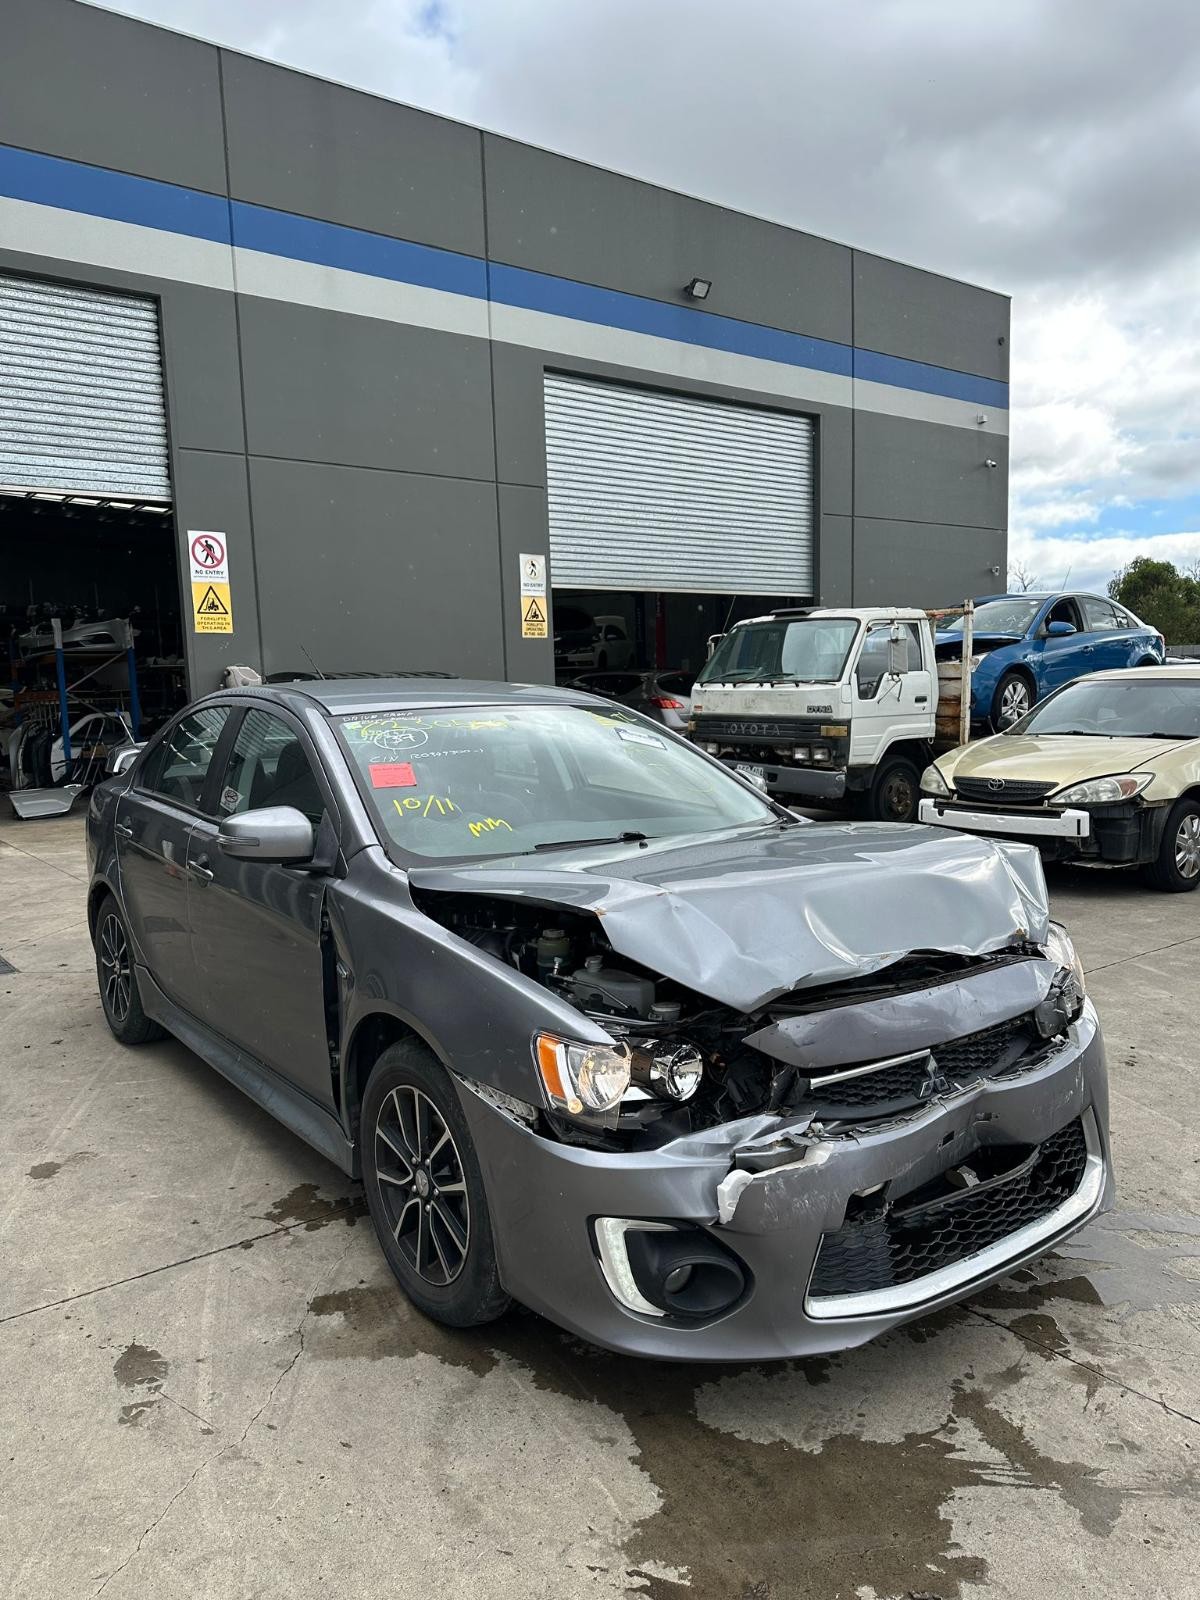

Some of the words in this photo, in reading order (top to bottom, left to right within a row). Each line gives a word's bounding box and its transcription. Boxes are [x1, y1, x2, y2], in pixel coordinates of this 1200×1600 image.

[806, 705, 833, 714] DYNA
[722, 722, 780, 736] TOYOTA
[392, 794, 455, 818] 10/11
